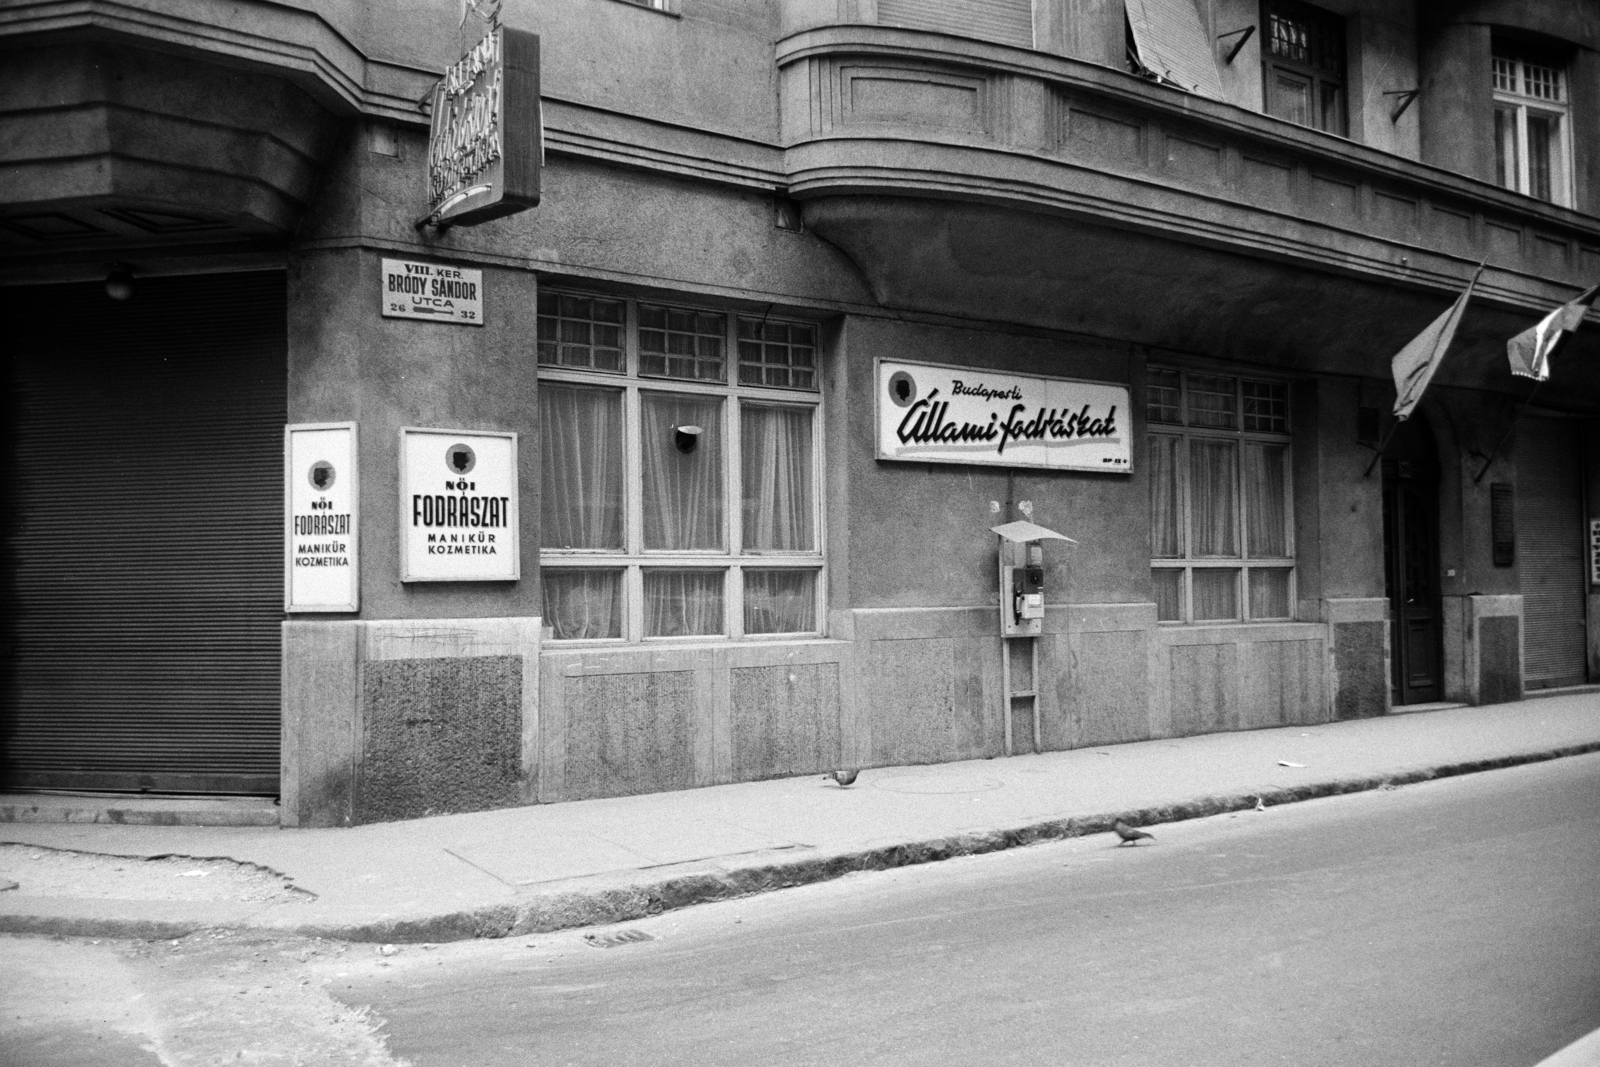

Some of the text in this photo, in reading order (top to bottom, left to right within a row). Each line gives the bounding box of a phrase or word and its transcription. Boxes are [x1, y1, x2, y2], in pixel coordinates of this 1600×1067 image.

[404, 263, 464, 280] VIII. KER.
[388, 273, 477, 301] BRÓDY SÁNDOR
[411, 296, 455, 308] UTCA
[390, 303, 476, 319] 26 32
[951, 379, 1023, 402] Budapesti
[896, 388, 1117, 456] Állami fodrászat
[412, 491, 509, 528] FODRÁSZAT
[294, 511, 351, 536] FODRÁSZAT
[427, 531, 496, 544] MANIKÜR
[428, 545, 497, 556] KOZMETIKA
[295, 557, 349, 567] KOZMETIKA
